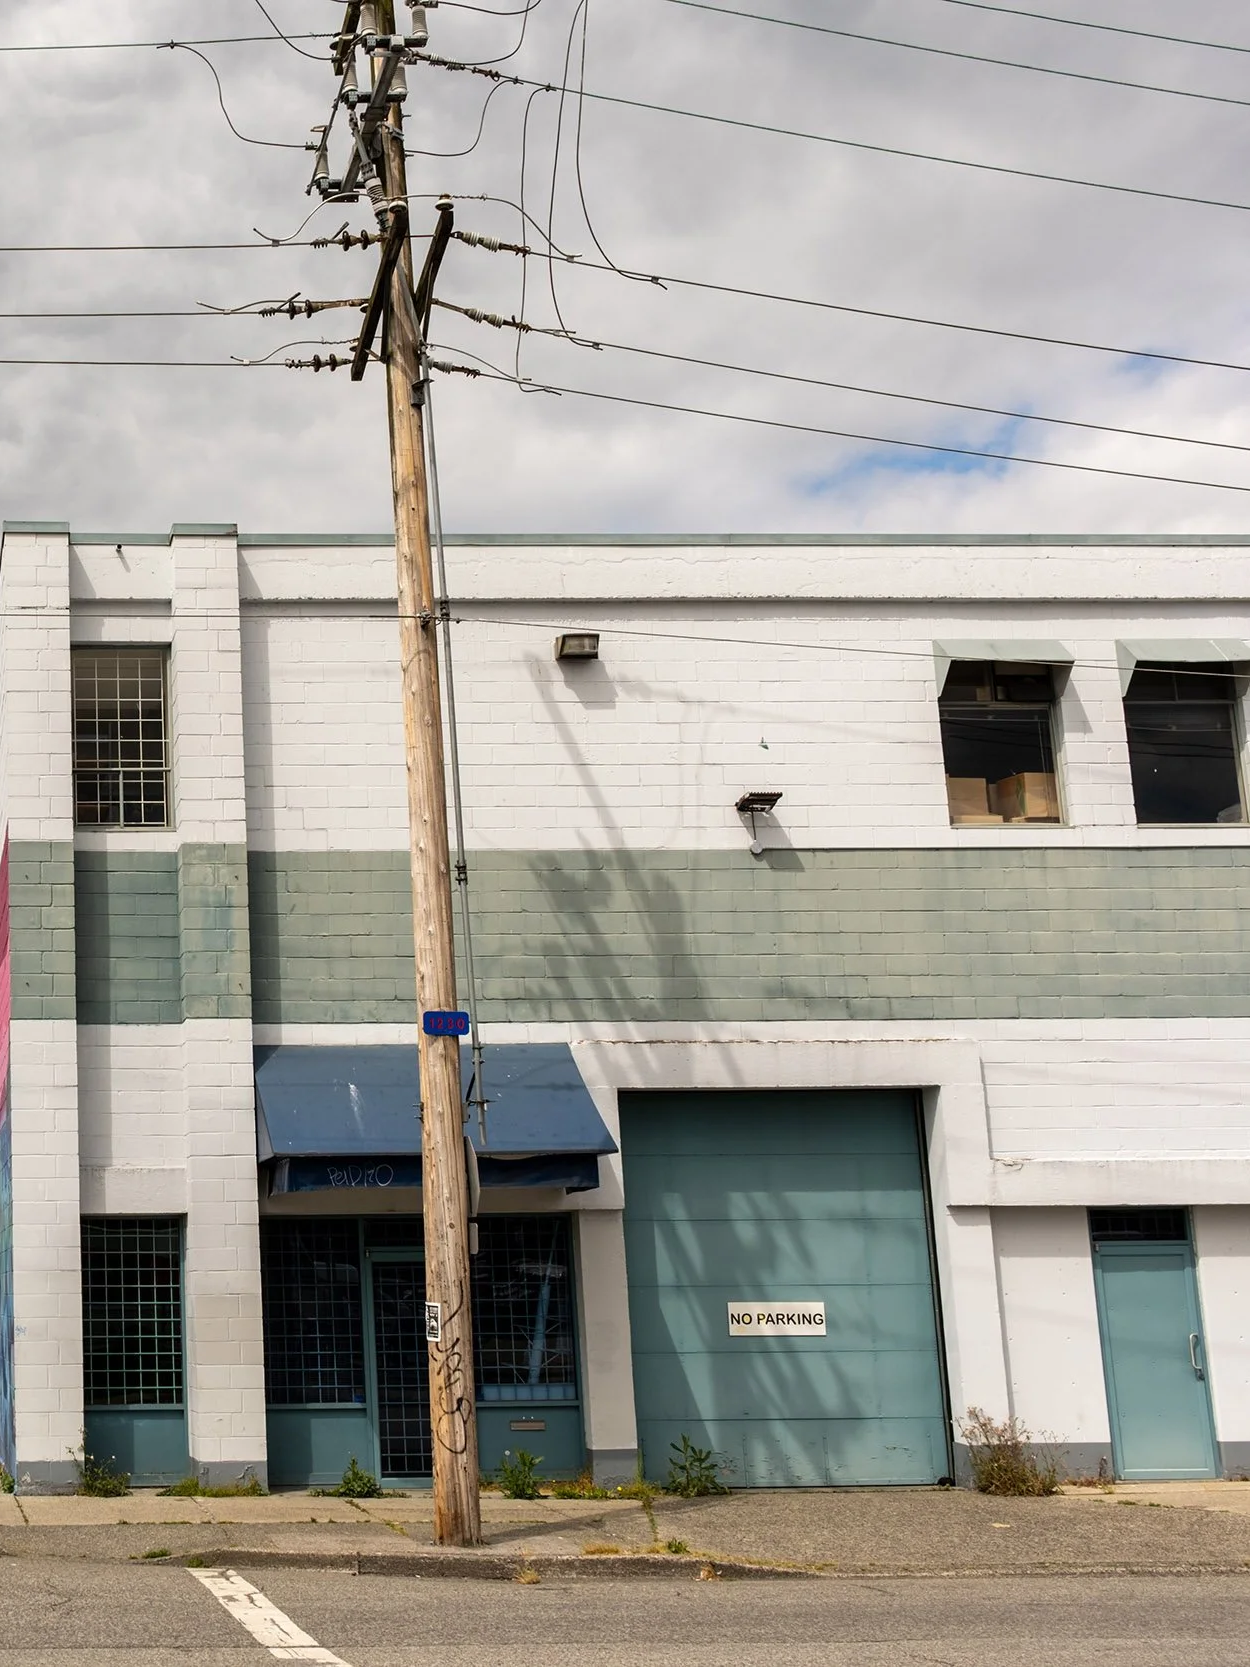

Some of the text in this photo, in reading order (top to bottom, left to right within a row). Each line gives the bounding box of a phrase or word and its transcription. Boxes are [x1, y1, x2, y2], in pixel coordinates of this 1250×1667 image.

[430, 1017, 465, 1030] 1230
[730, 1313, 824, 1325] NO PARKING
